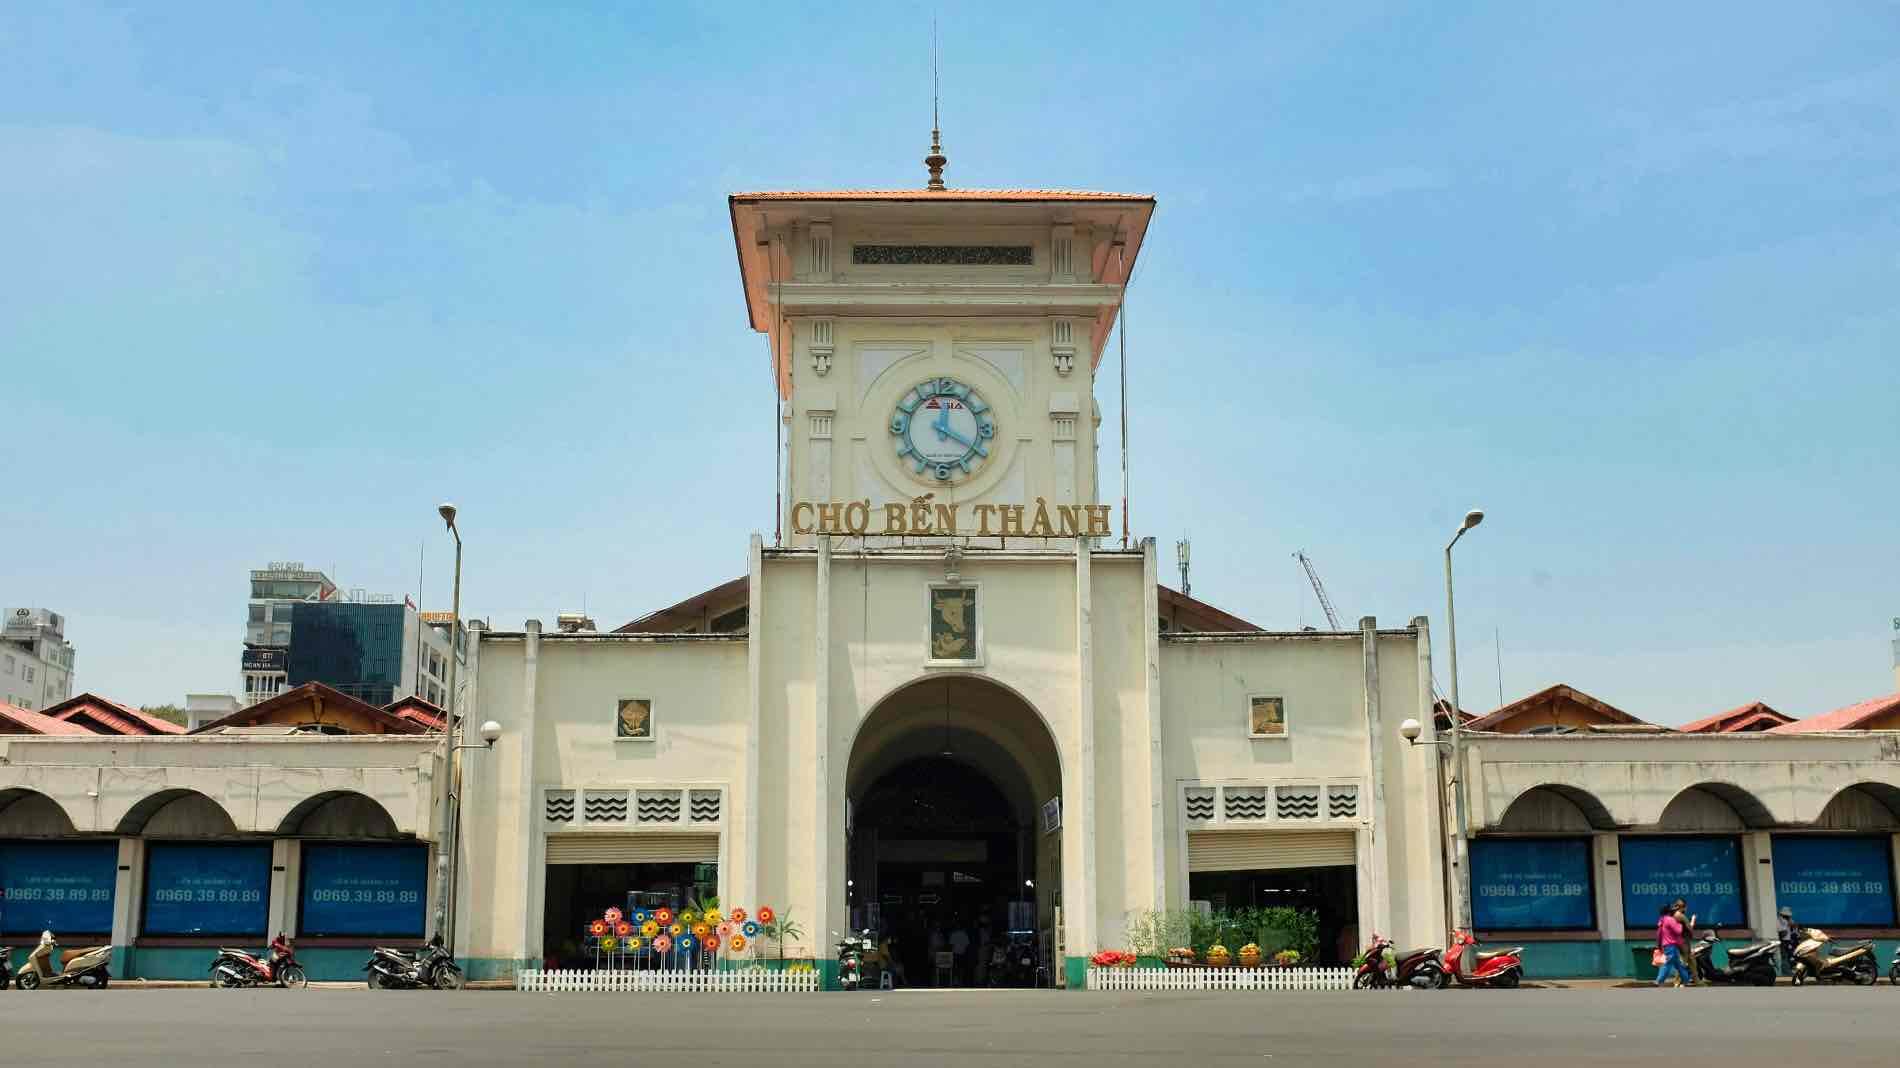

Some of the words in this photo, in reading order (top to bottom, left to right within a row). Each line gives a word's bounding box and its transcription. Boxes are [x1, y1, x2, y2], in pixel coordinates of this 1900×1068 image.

[792, 499, 870, 537] CHỢ
[884, 493, 960, 536] BẾN
[972, 496, 1112, 536] THÀNH
[5, 887, 110, 901] 0969.39.89.89
[1480, 883, 1582, 896] 0969.39.89.89
[1632, 882, 1733, 895] 0969.39.89.89
[1781, 881, 1883, 894] 0969.39.89.89
[155, 889, 260, 902] 0969.39.89.89
[313, 889, 417, 902] 0969.39.89.89
